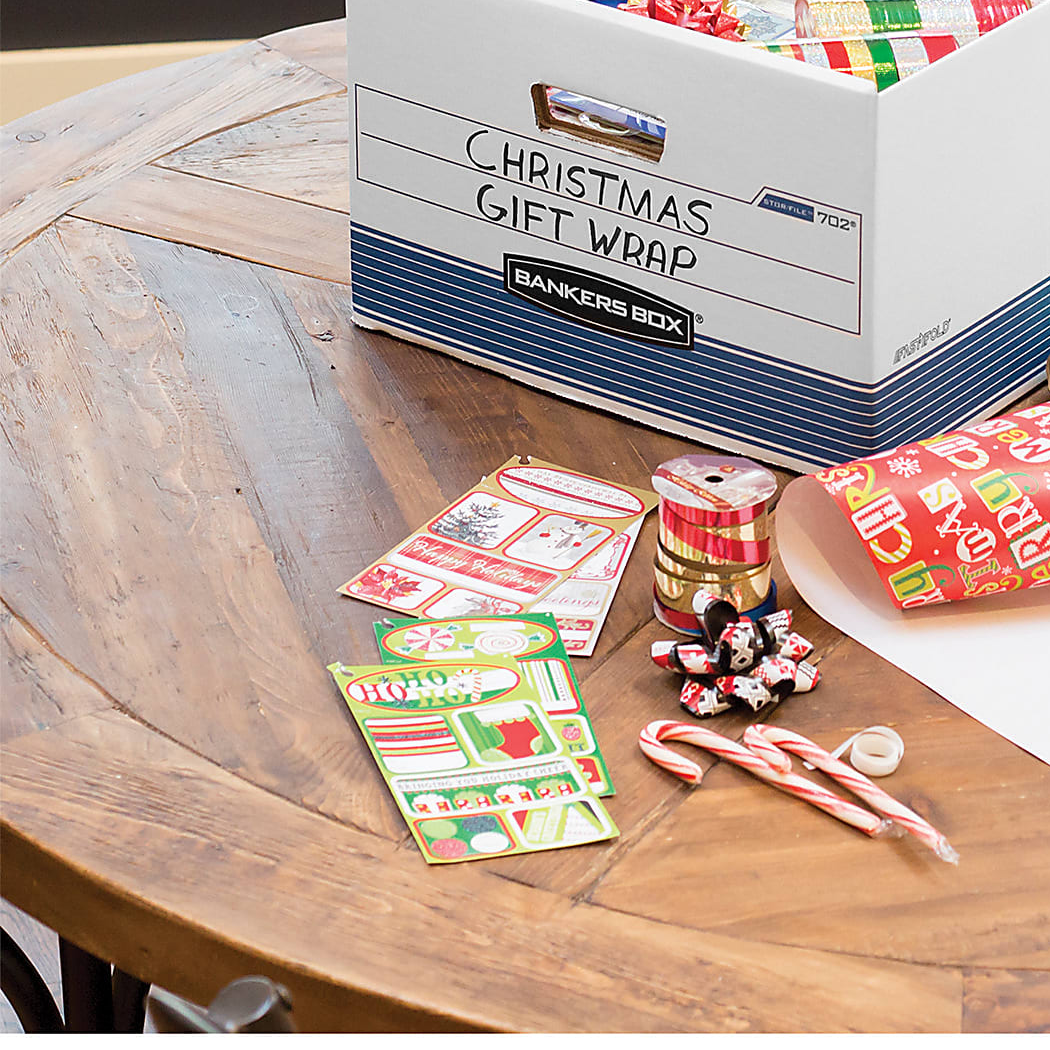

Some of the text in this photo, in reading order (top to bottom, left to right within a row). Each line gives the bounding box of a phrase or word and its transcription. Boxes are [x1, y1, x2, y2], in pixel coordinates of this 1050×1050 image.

[465, 129, 713, 237] CHRISTMAS
[476, 183, 698, 277] GIFT WRAP
[514, 268, 684, 336] BANKERS BOX
[413, 540, 469, 571] Happy
[354, 682, 408, 703] HO
[397, 670, 448, 689] HO
[416, 686, 466, 708] HO
[481, 770, 530, 784] HOLIDAY
[533, 763, 568, 777] CHEER
